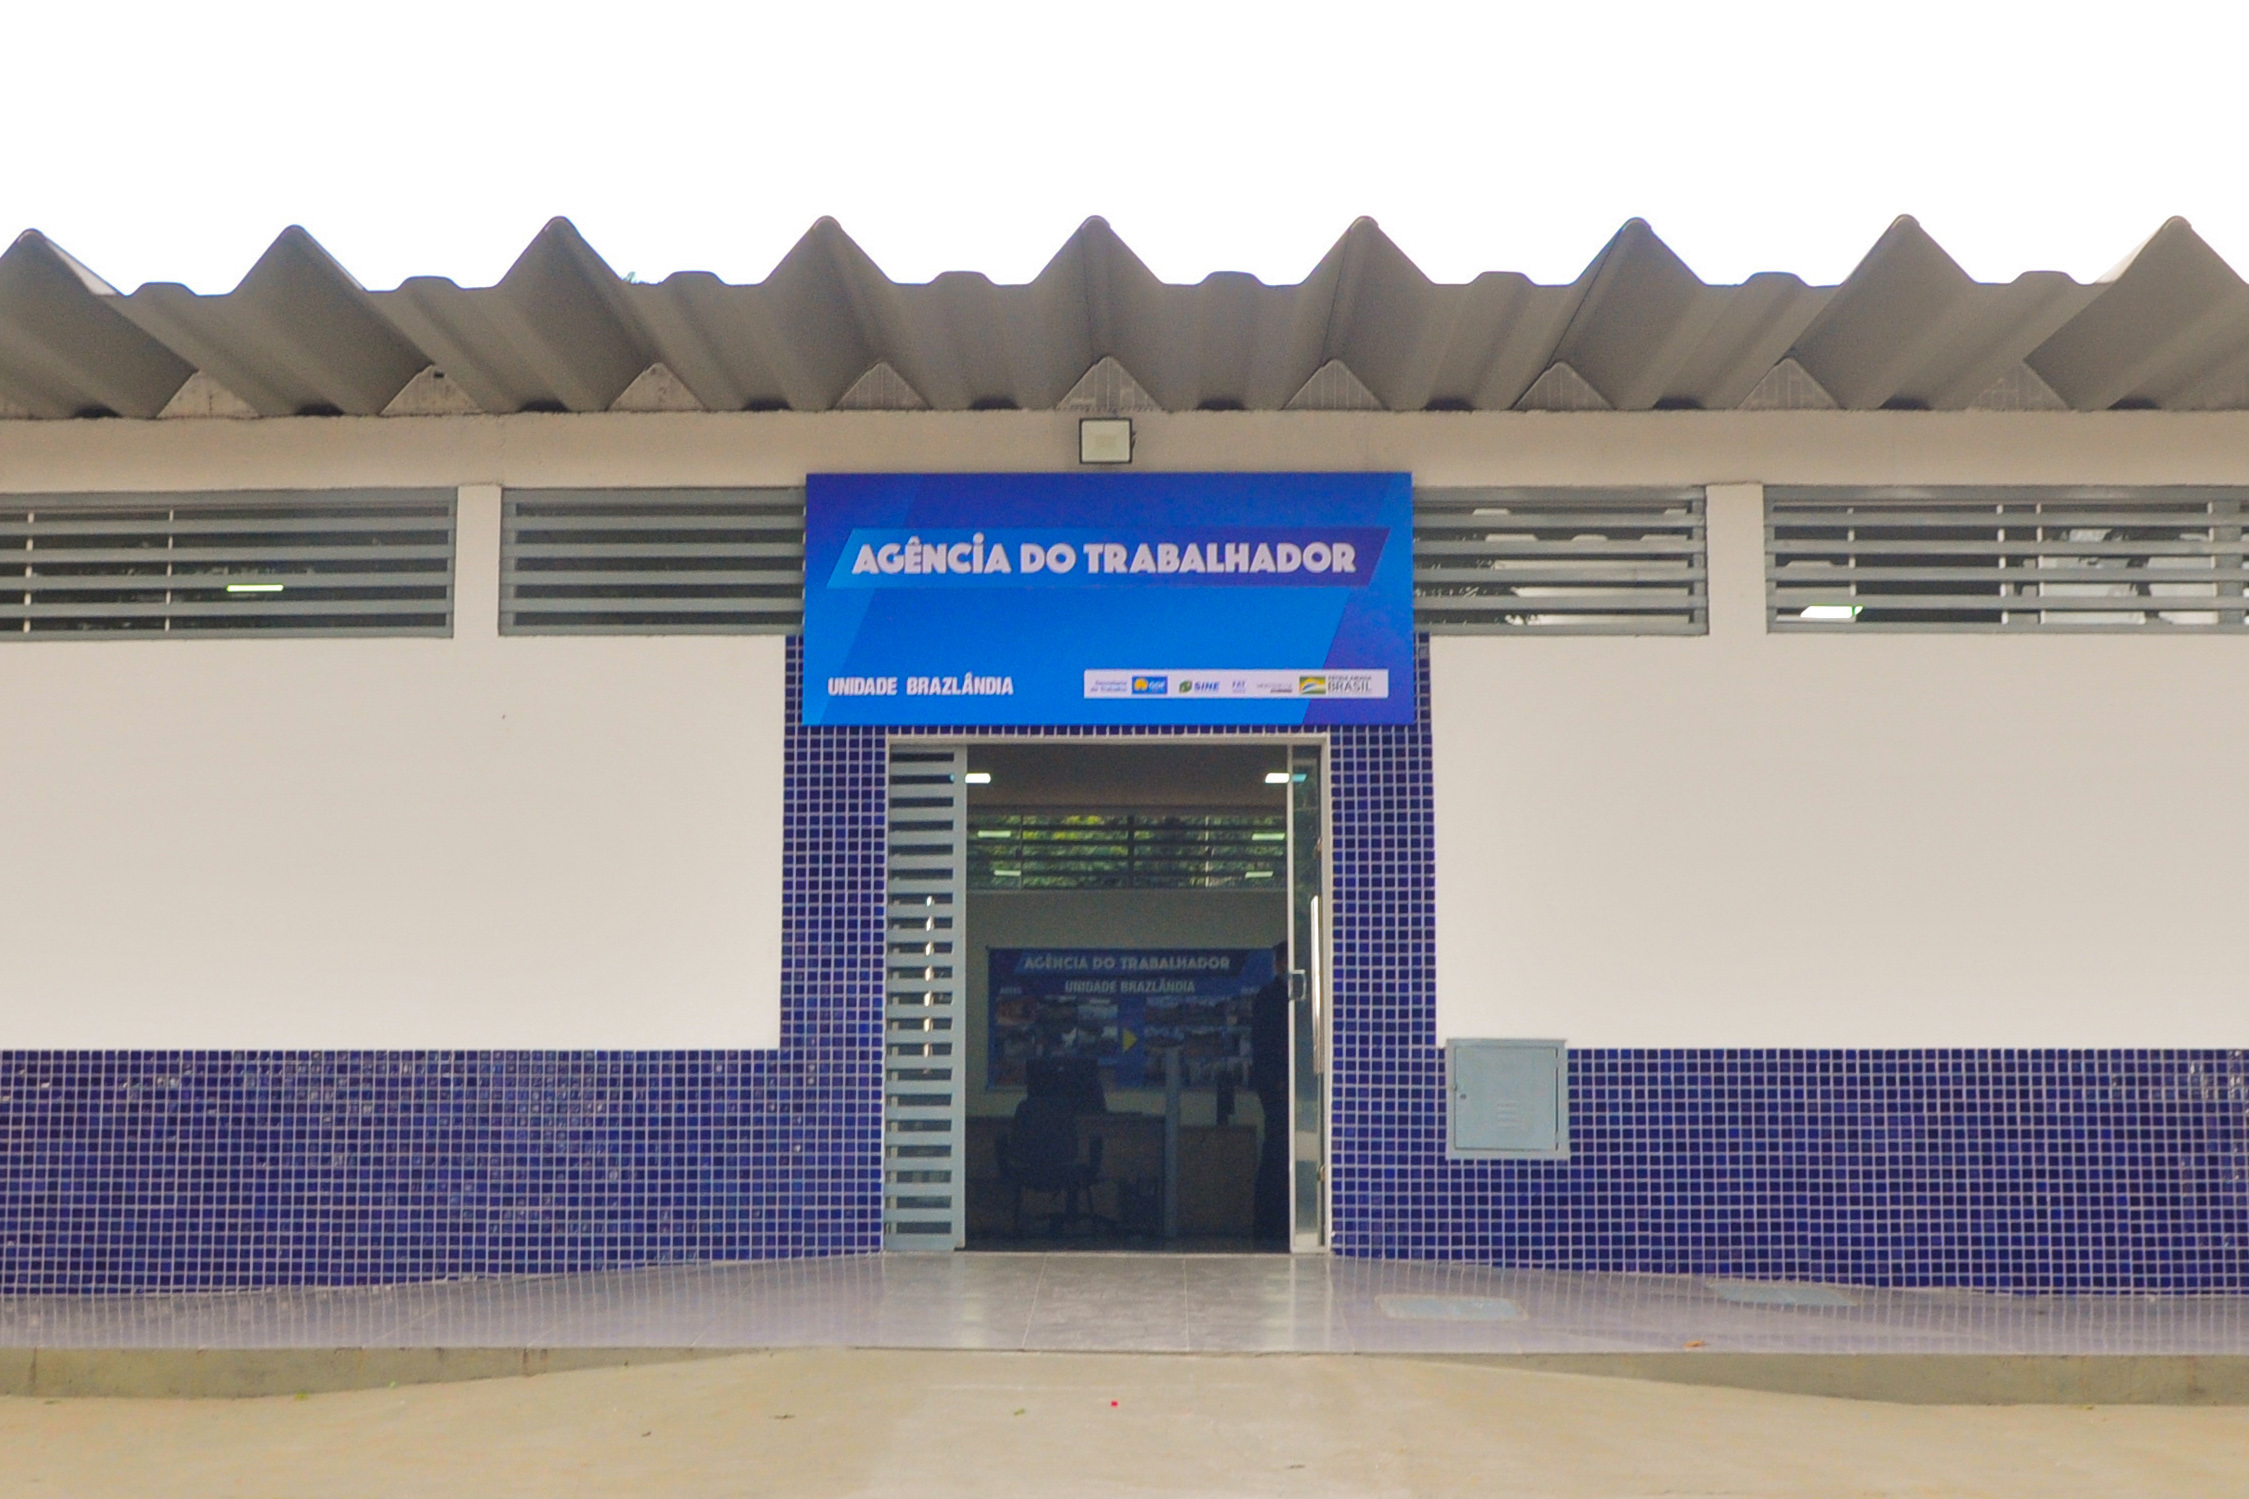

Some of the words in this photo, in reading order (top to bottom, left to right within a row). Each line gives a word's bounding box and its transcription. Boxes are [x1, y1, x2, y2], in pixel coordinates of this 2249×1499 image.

[851, 532, 1012, 574] AGÊNCIA
[1020, 543, 1076, 574] DO
[1083, 542, 1356, 574] TRABALHADOR
[828, 677, 898, 696] UNIDADE
[906, 671, 1014, 696] BRAZLÂNDIA
[1194, 681, 1219, 692] SINE
[1328, 680, 1371, 692] BRASIL
[1024, 954, 1088, 970] AGÊNCIA
[1093, 956, 1115, 970] DO
[1121, 956, 1230, 970] TRABALHADOR
[1064, 980, 1117, 994] UNIDADE
[1120, 977, 1196, 994] BRAZLÂNDIA
